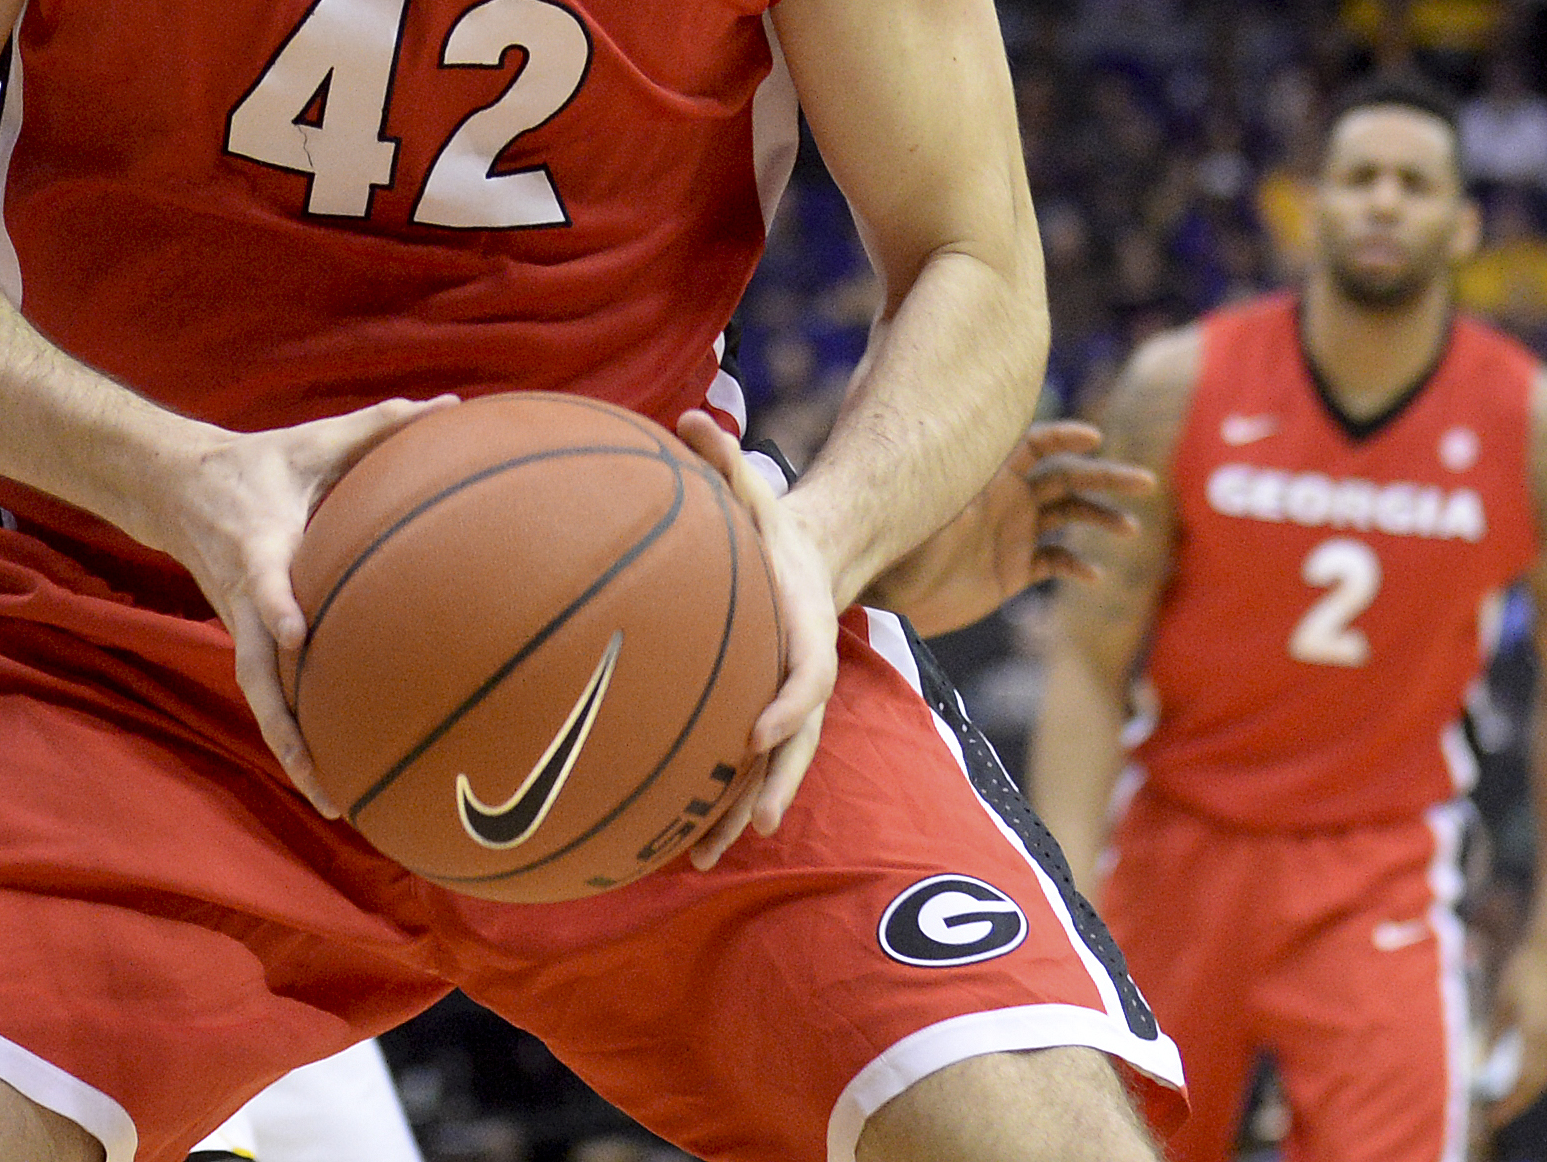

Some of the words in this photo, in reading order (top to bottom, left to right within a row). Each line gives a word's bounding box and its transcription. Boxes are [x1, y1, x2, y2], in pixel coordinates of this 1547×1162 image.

[1206, 462, 1488, 543] GEORGIA
[1288, 535, 1384, 668] 2
[880, 875, 1027, 966] G
